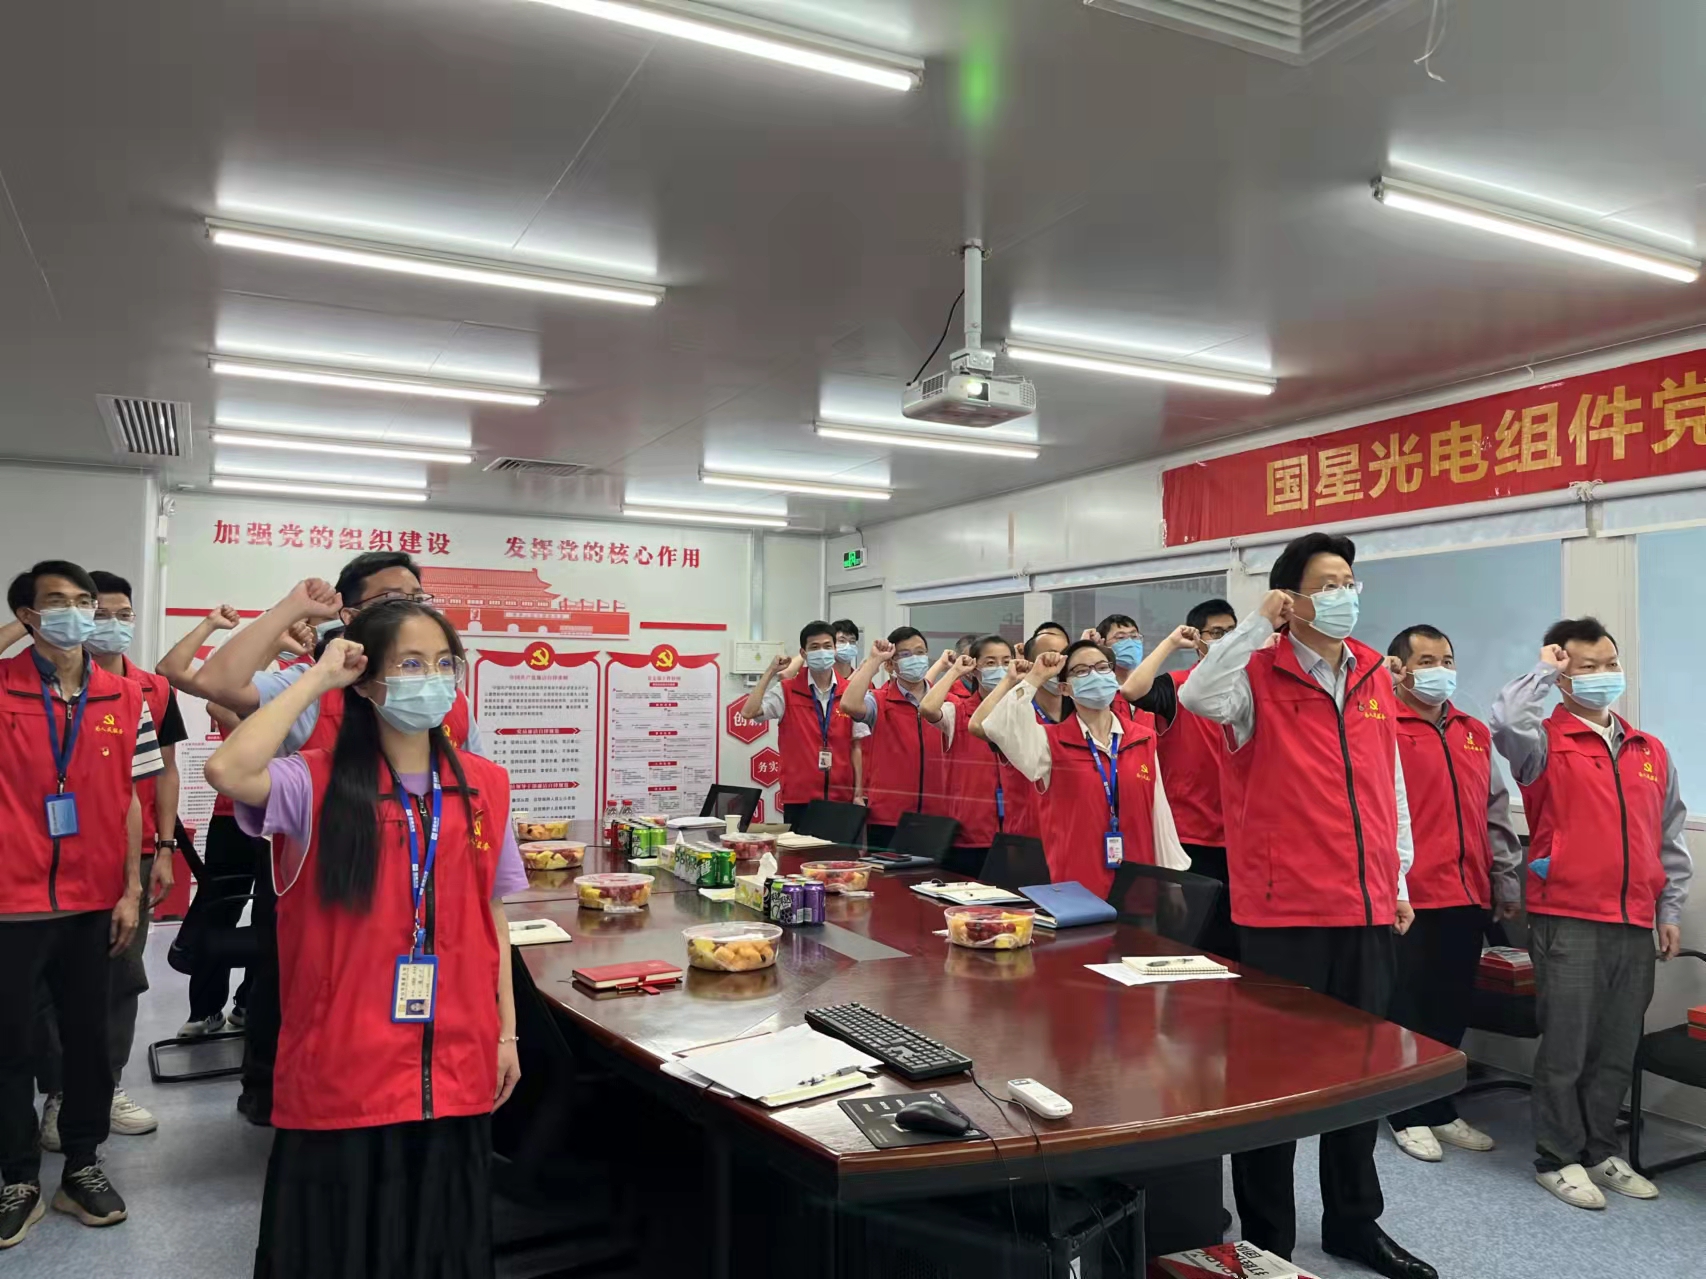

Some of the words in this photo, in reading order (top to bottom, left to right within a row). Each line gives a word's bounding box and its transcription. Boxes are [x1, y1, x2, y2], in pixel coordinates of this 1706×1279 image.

[1266, 370, 1706, 515] 国星光电组件党
[213, 519, 452, 556] 加强党的组织建设
[503, 536, 701, 568] 发挥党的核心作用
[757, 761, 779, 773] 务实
